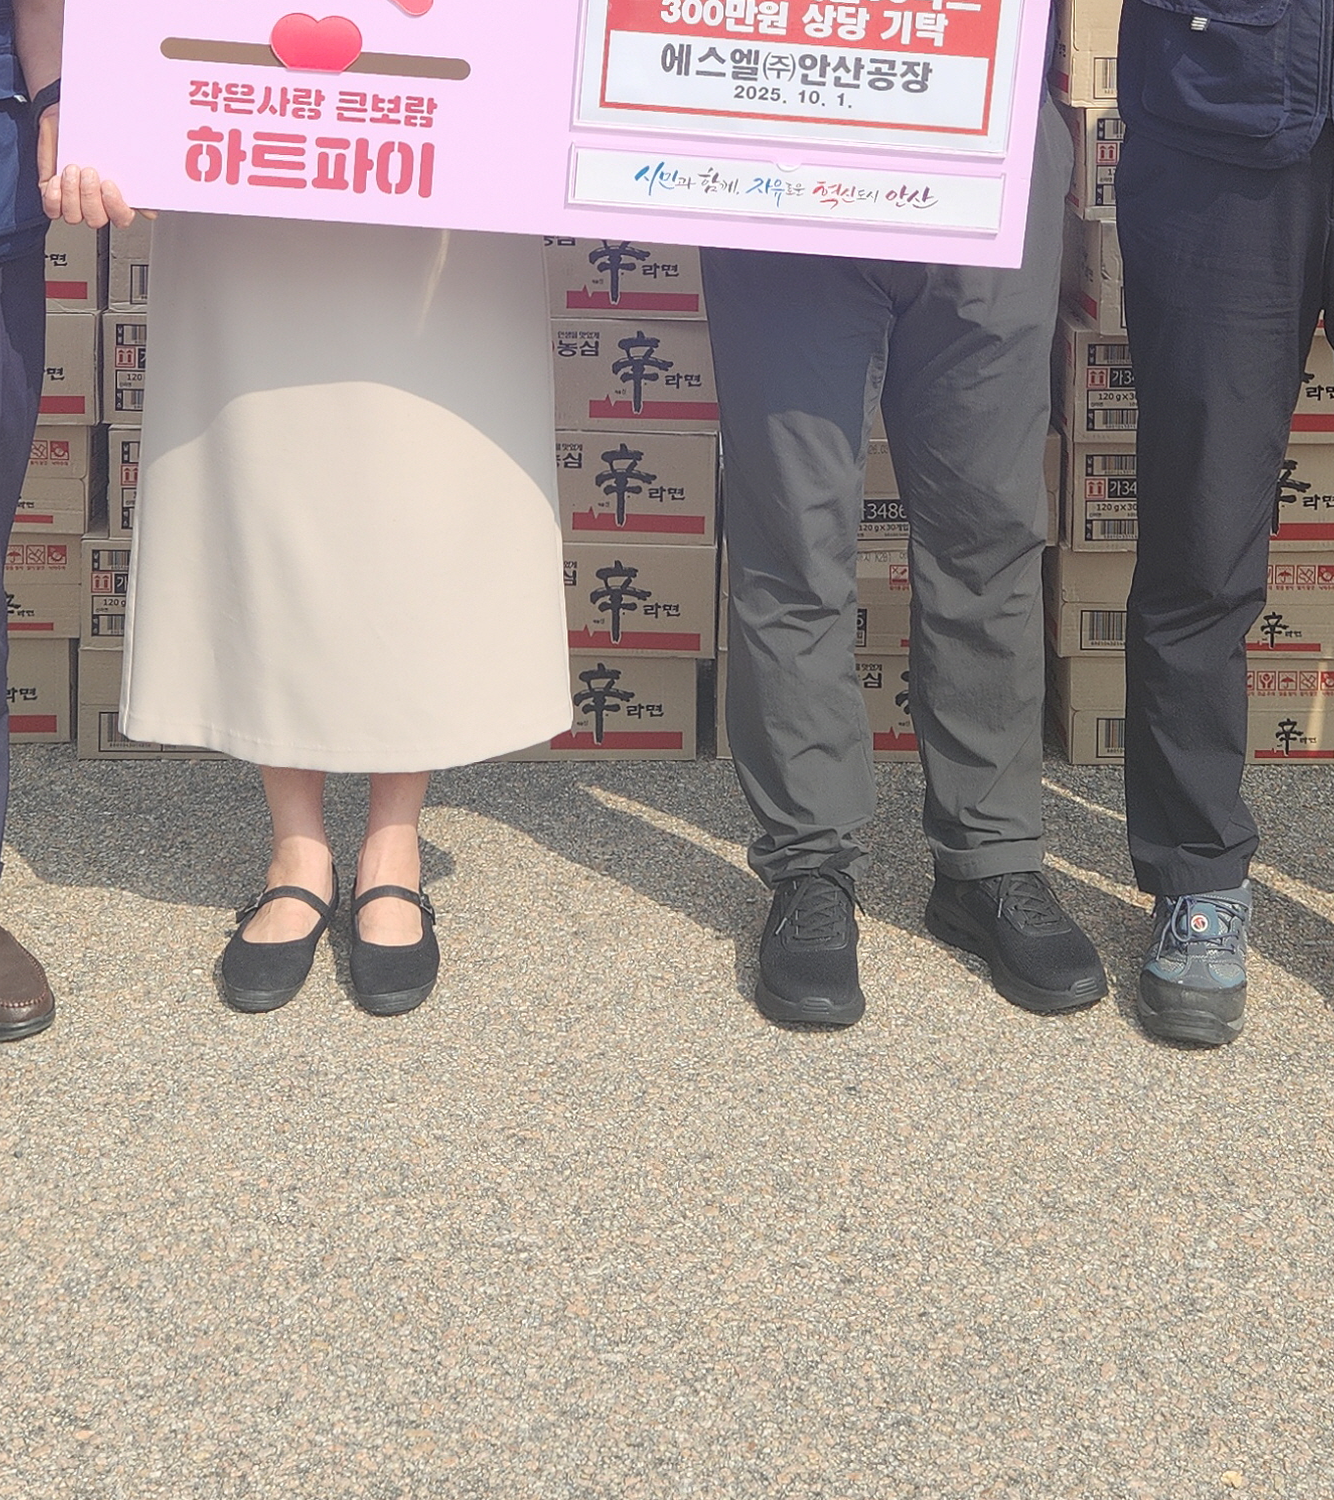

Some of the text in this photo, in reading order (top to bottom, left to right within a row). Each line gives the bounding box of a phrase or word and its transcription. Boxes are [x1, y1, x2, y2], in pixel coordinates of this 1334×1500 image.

[802, 3, 870, 41] 상당
[880, 10, 949, 47] 기탁
[188, 80, 438, 128] 작은사랑 큰보람
[734, 85, 853, 109] 2025. 10. 1.
[185, 125, 435, 198] 하트파이
[634, 161, 697, 195] 시민과
[745, 177, 806, 208] 자유로운
[812, 180, 879, 209] 혁신도시
[885, 184, 940, 209] 안산
[642, 264, 680, 278] 라면
[558, 341, 600, 357] 농심
[612, 331, 673, 414] 辛
[665, 374, 702, 389] 라면
[596, 443, 657, 527] 辛
[649, 487, 685, 501] 라면
[590, 560, 652, 644] 辛
[643, 603, 681, 618] 라면
[1261, 611, 1289, 649] 辛
[573, 663, 635, 745] 辛
[627, 704, 664, 719] 라면
[1276, 719, 1304, 756] 辛
